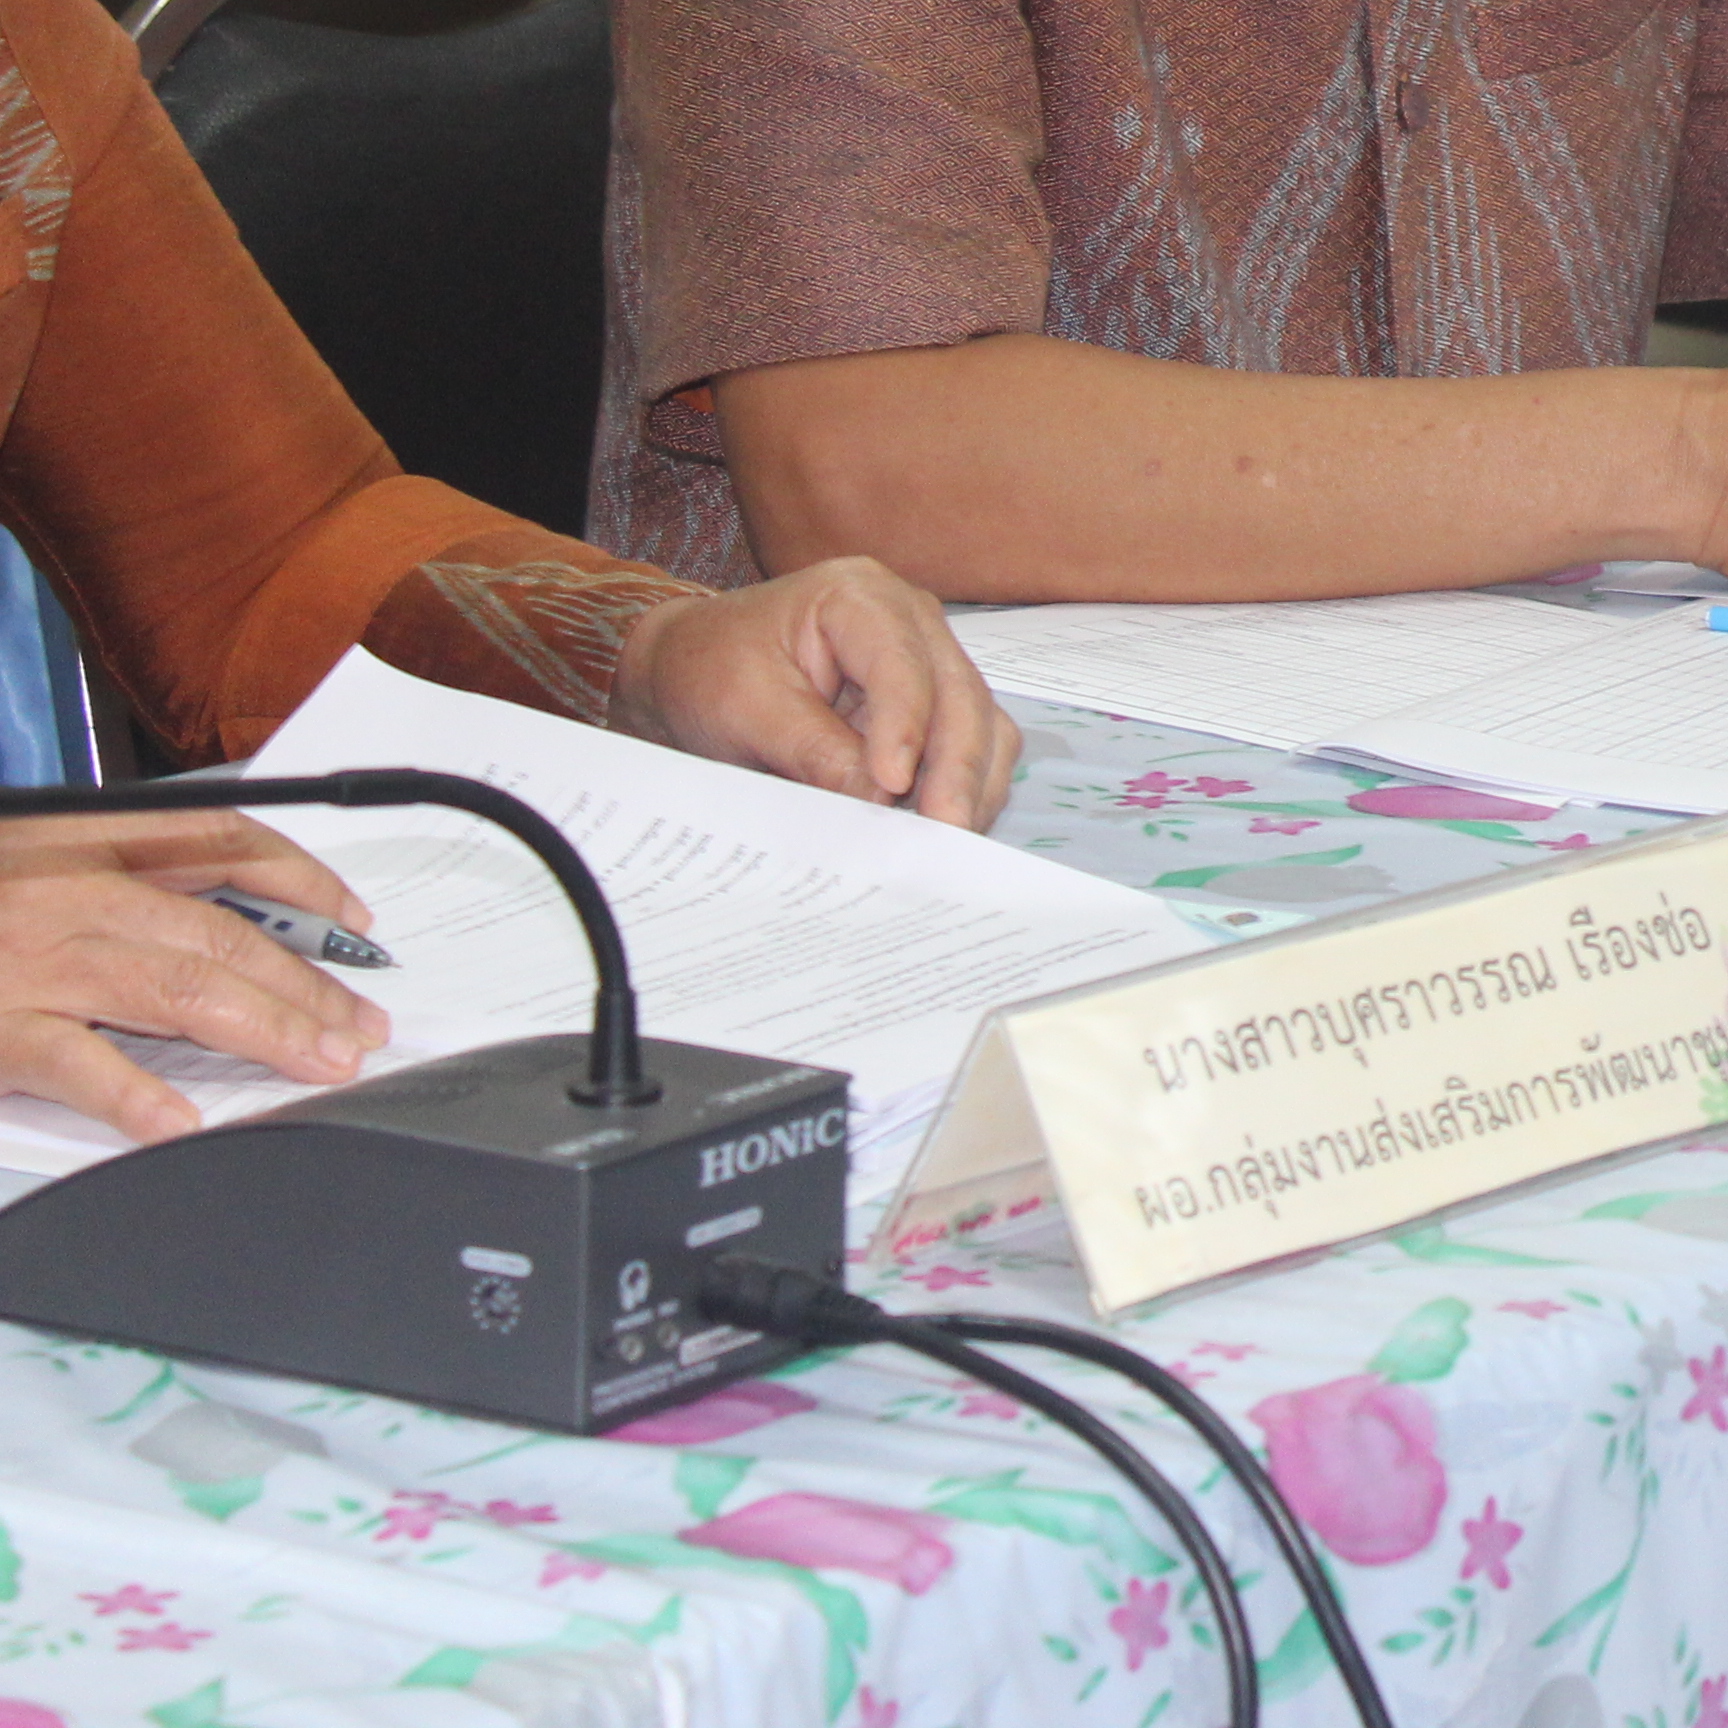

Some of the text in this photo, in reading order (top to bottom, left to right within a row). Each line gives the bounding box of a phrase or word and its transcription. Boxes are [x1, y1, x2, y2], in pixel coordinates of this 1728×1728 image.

[1142, 891, 1711, 1092] นางสาวบุศราวรรณ เรืองช่อ
